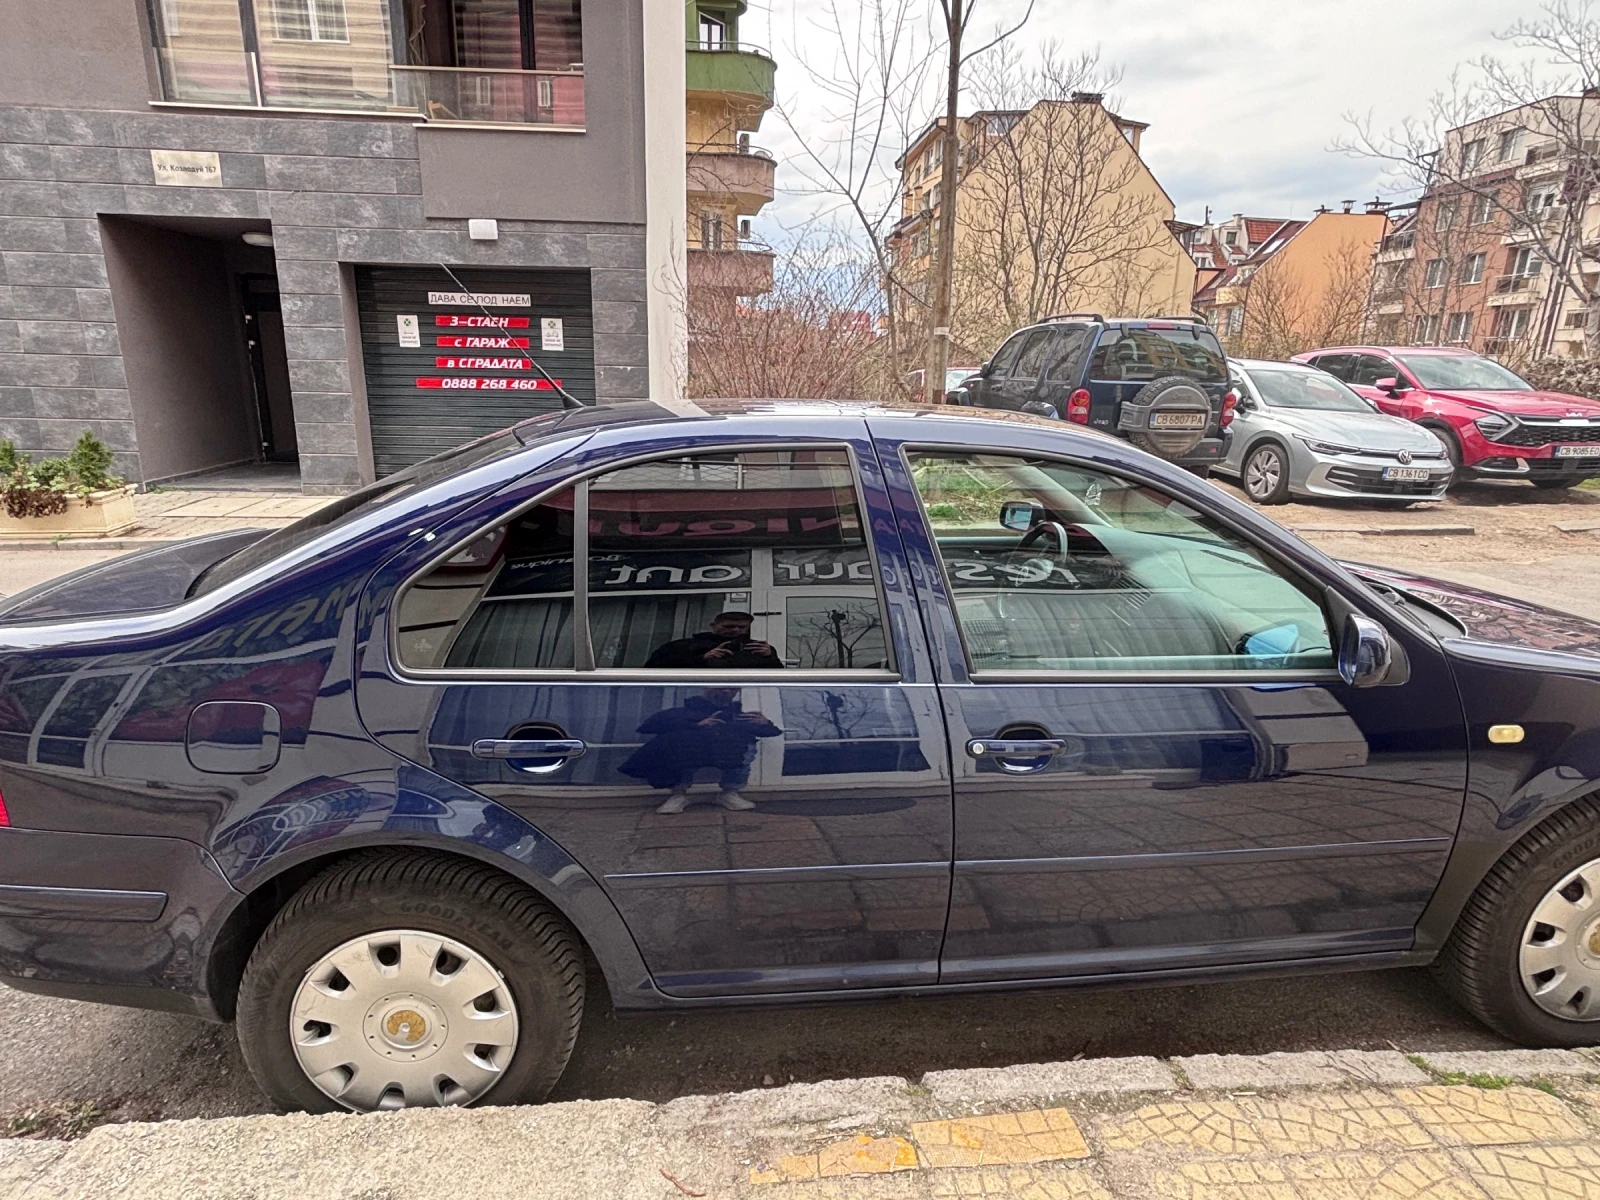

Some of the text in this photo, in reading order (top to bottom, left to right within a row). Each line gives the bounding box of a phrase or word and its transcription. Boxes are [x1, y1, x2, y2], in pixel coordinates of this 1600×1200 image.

[170, 164, 204, 173] Козлодуй
[430, 294, 530, 305] ДАВА СЕ ПОД НАЕМ
[465, 337, 511, 348] ГАРАЖ
[447, 358, 524, 369] в СГРАДАТА
[441, 378, 537, 390] 0888 268 460
[1155, 415, 1203, 425] CB 6807 PA
[1387, 468, 1399, 478] CB
[1400, 469, 1417, 479] 1361
